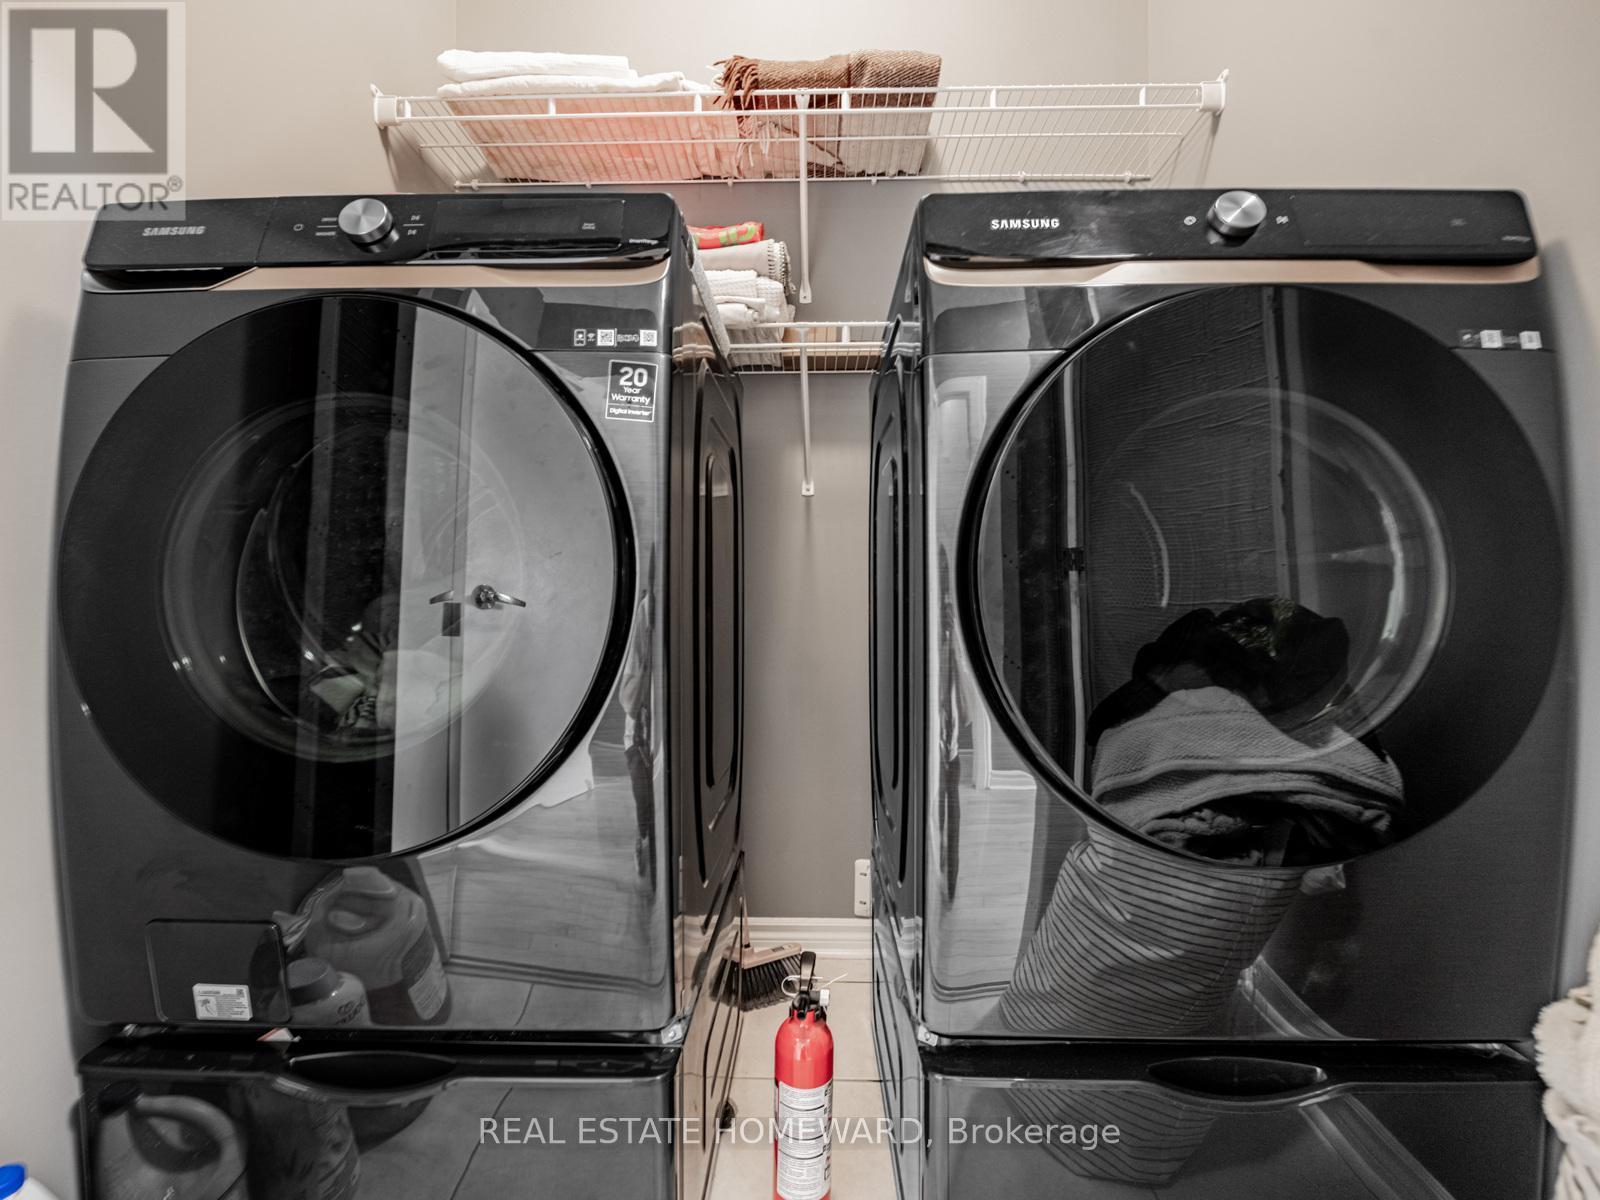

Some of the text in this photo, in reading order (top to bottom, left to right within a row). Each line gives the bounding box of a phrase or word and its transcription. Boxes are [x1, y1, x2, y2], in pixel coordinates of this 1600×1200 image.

[990, 218, 1060, 229] SAMSUNG
[142, 226, 206, 236] SAMSUNG
[619, 366, 648, 387] 20
[623, 386, 642, 394] Year
[611, 392, 651, 405] Warranty
